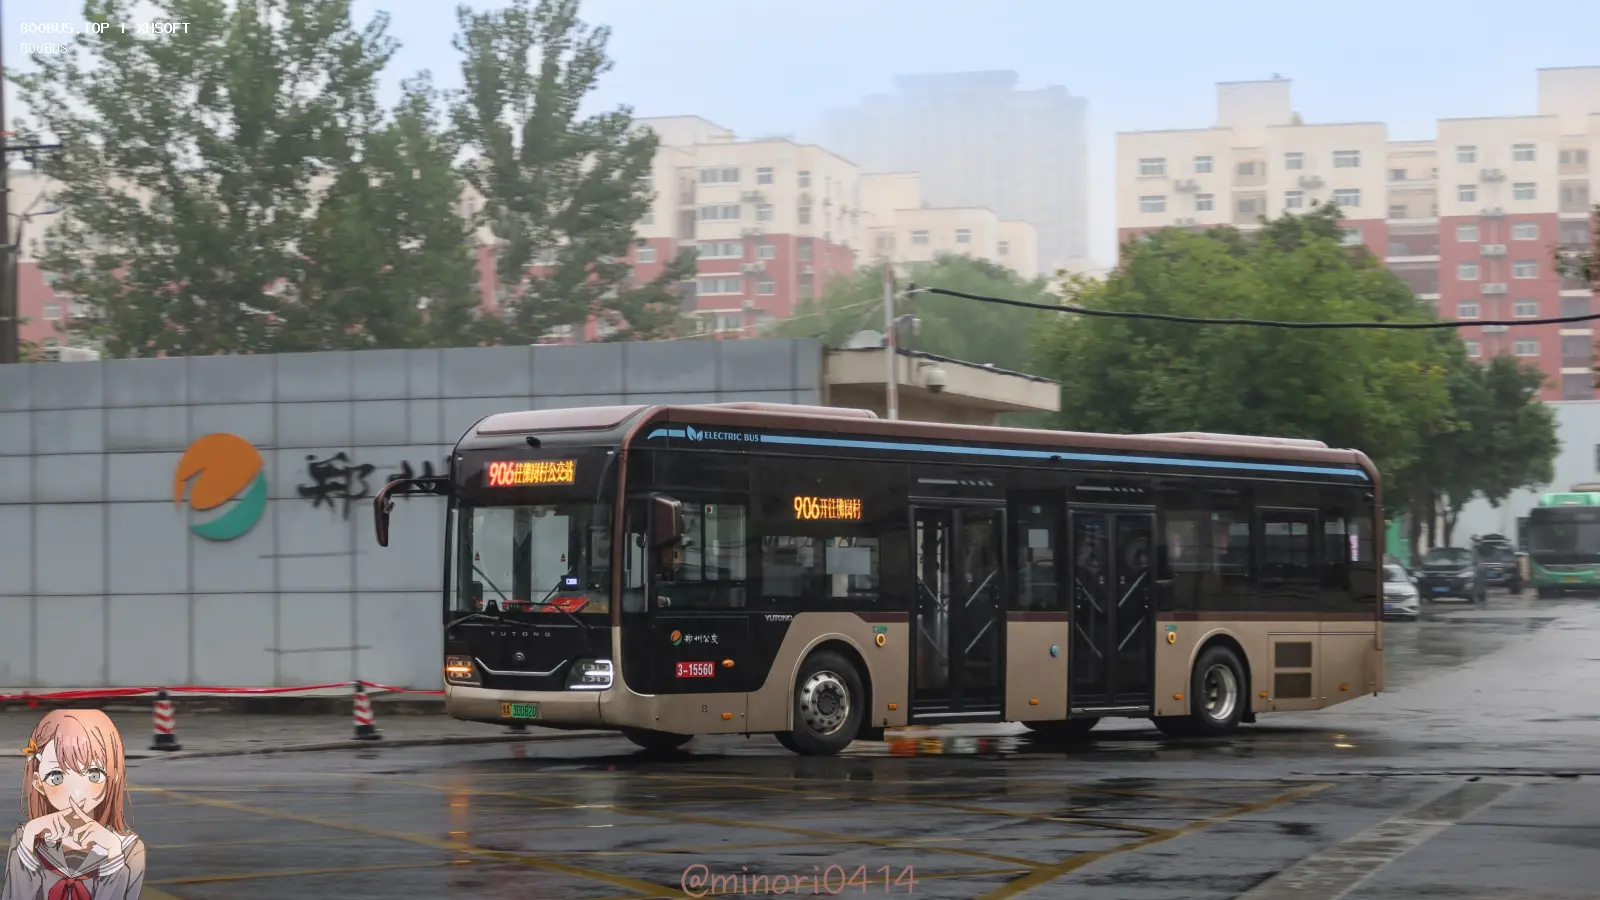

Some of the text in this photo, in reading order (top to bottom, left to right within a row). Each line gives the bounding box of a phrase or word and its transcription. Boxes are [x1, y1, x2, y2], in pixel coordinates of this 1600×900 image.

[704, 431, 759, 442] ELECTRIC BUS
[677, 663, 713, 676] 3-15560
